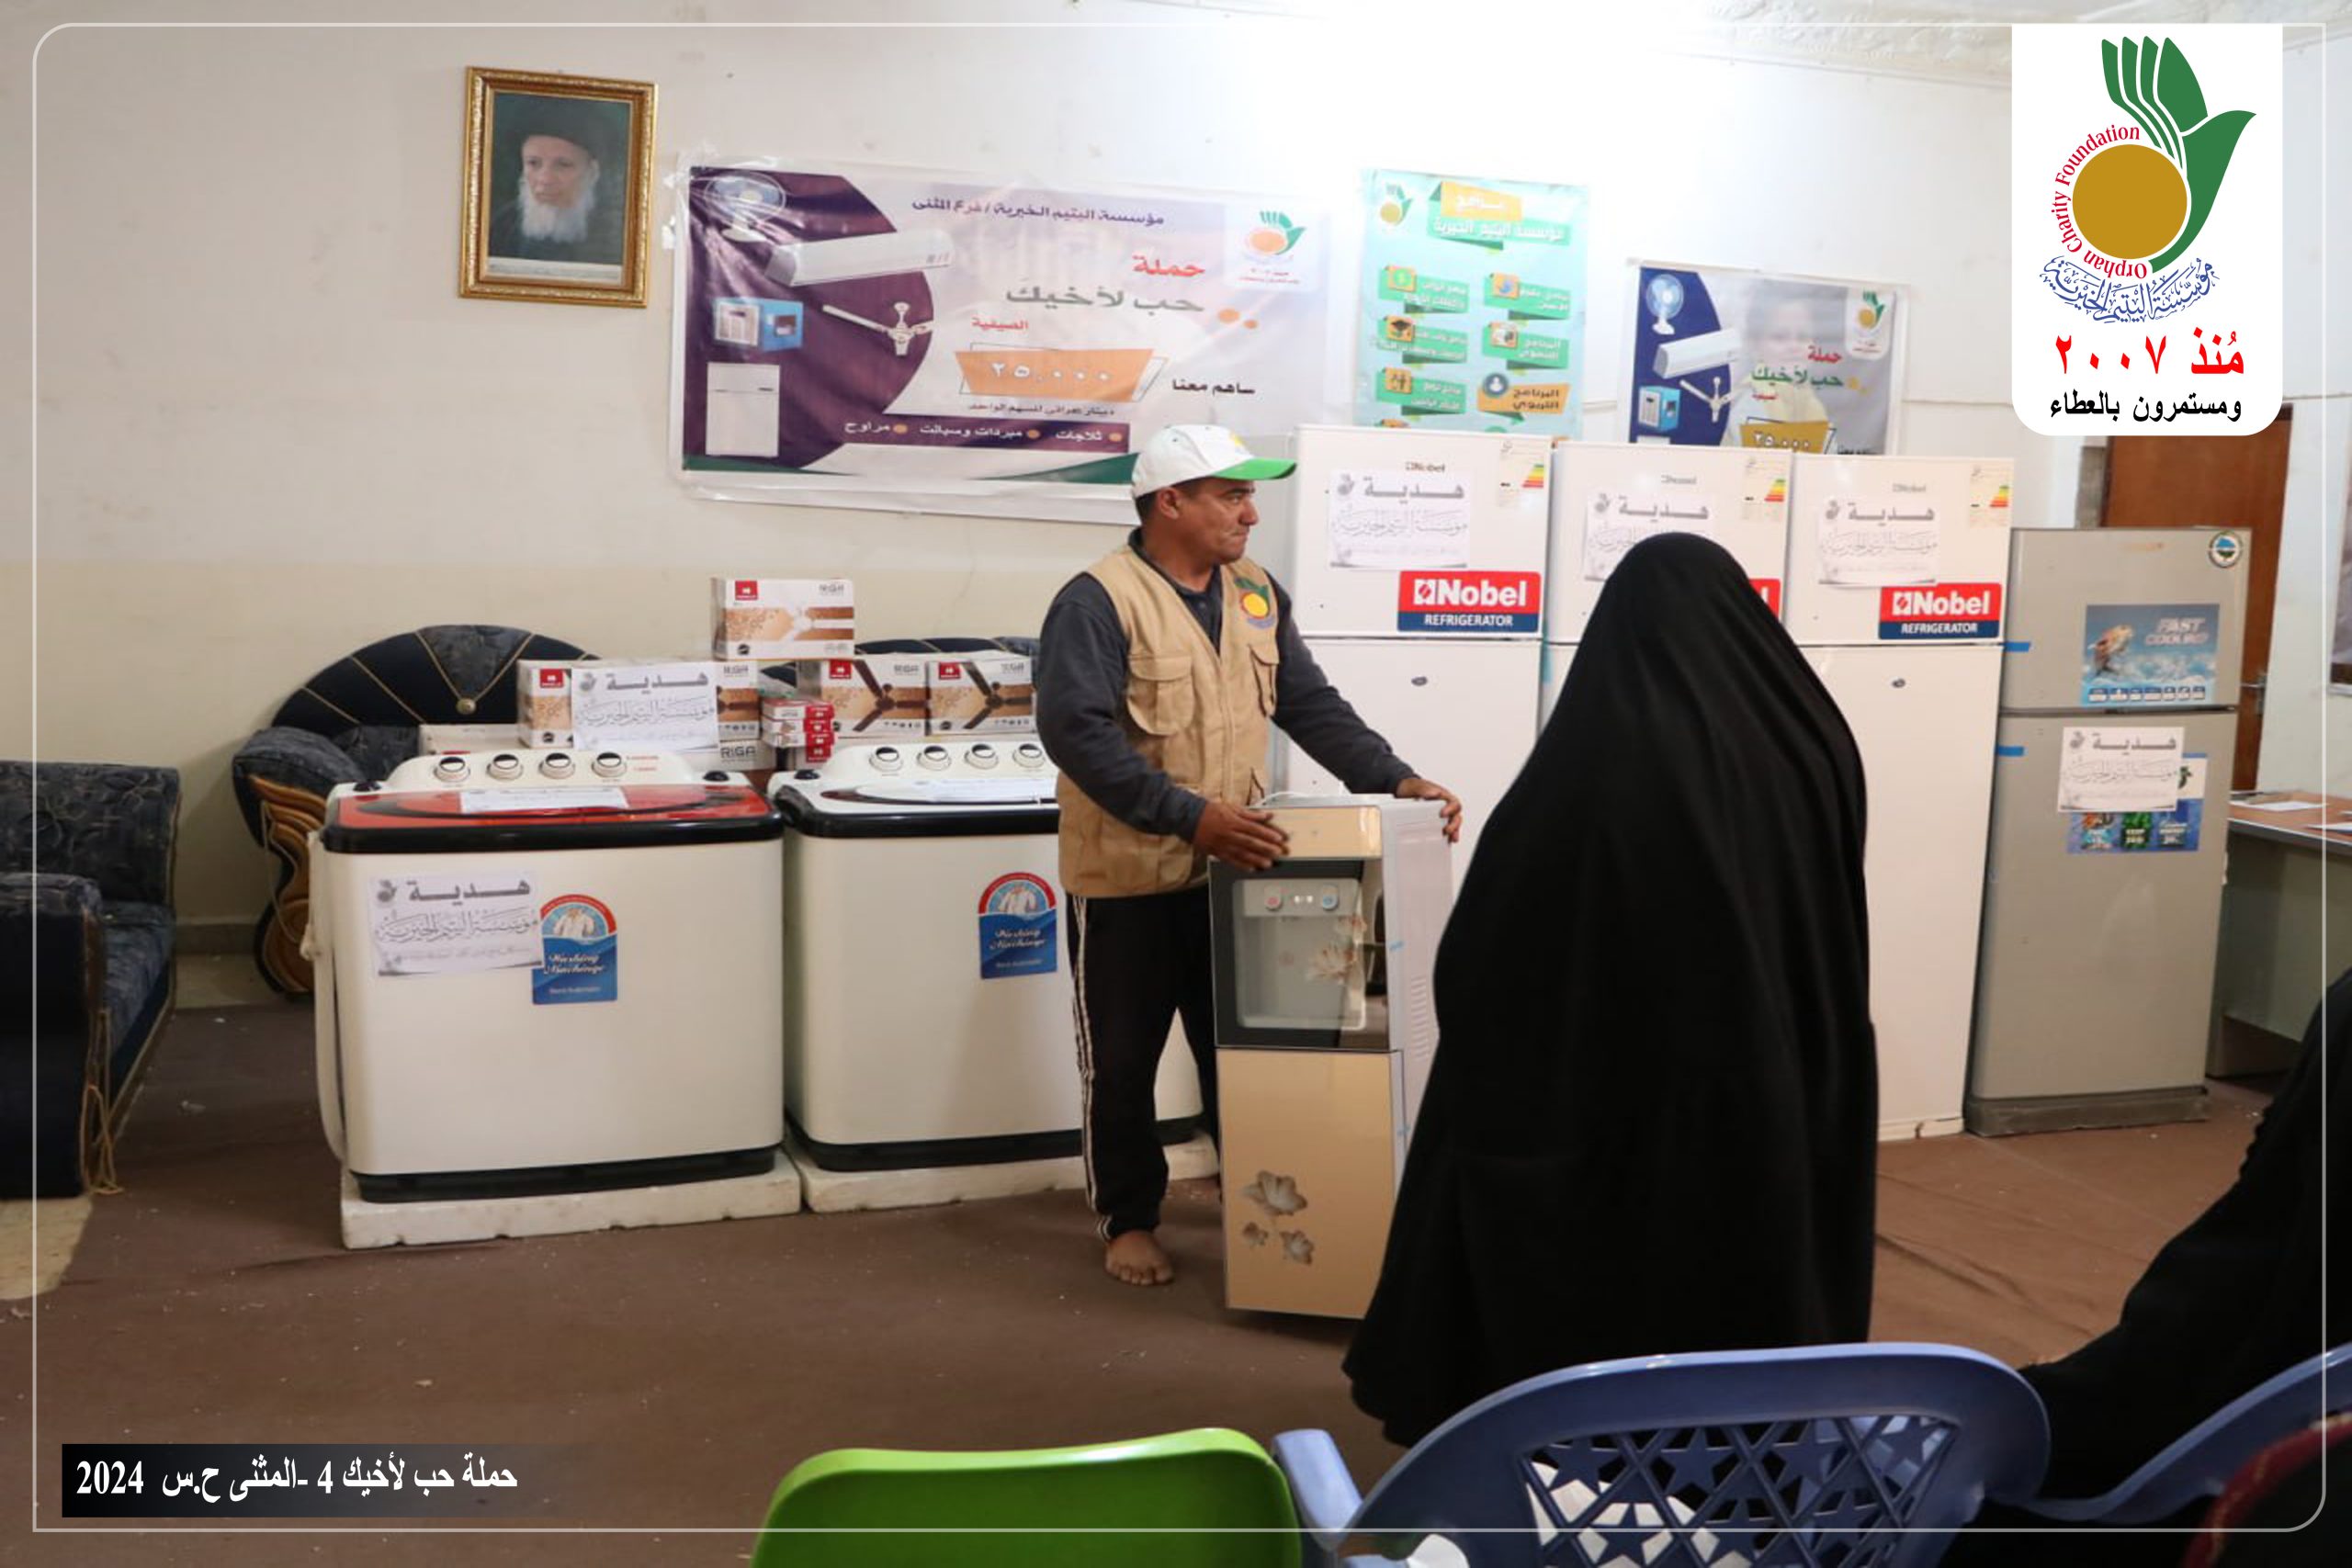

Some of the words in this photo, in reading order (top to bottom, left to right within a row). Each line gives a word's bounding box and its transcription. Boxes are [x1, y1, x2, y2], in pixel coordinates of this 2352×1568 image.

[993, 204, 1050, 220] الخيرية
[1053, 209, 1094, 222] اليتيم
[1099, 211, 1164, 227] مؤسسة
[1132, 254, 1205, 277] حملة
[1133, 296, 1205, 317] حب
[1807, 344, 1843, 365] حملة
[1172, 378, 1208, 393] معنا
[1213, 380, 1256, 396] ساهم
[1810, 374, 1844, 391] حب
[844, 421, 891, 434] مراوح
[1363, 476, 1464, 505] هدية
[1848, 502, 1935, 526] هدية
[1437, 579, 1527, 606] Nobel
[1912, 591, 1990, 615] Nobel
[1424, 614, 1513, 626] REFRIGERATOR
[1901, 622, 1978, 634] REFRIGERATOR
[605, 671, 708, 694] هدية
[720, 746, 757, 760] RIGA
[406, 879, 531, 906] هدية
